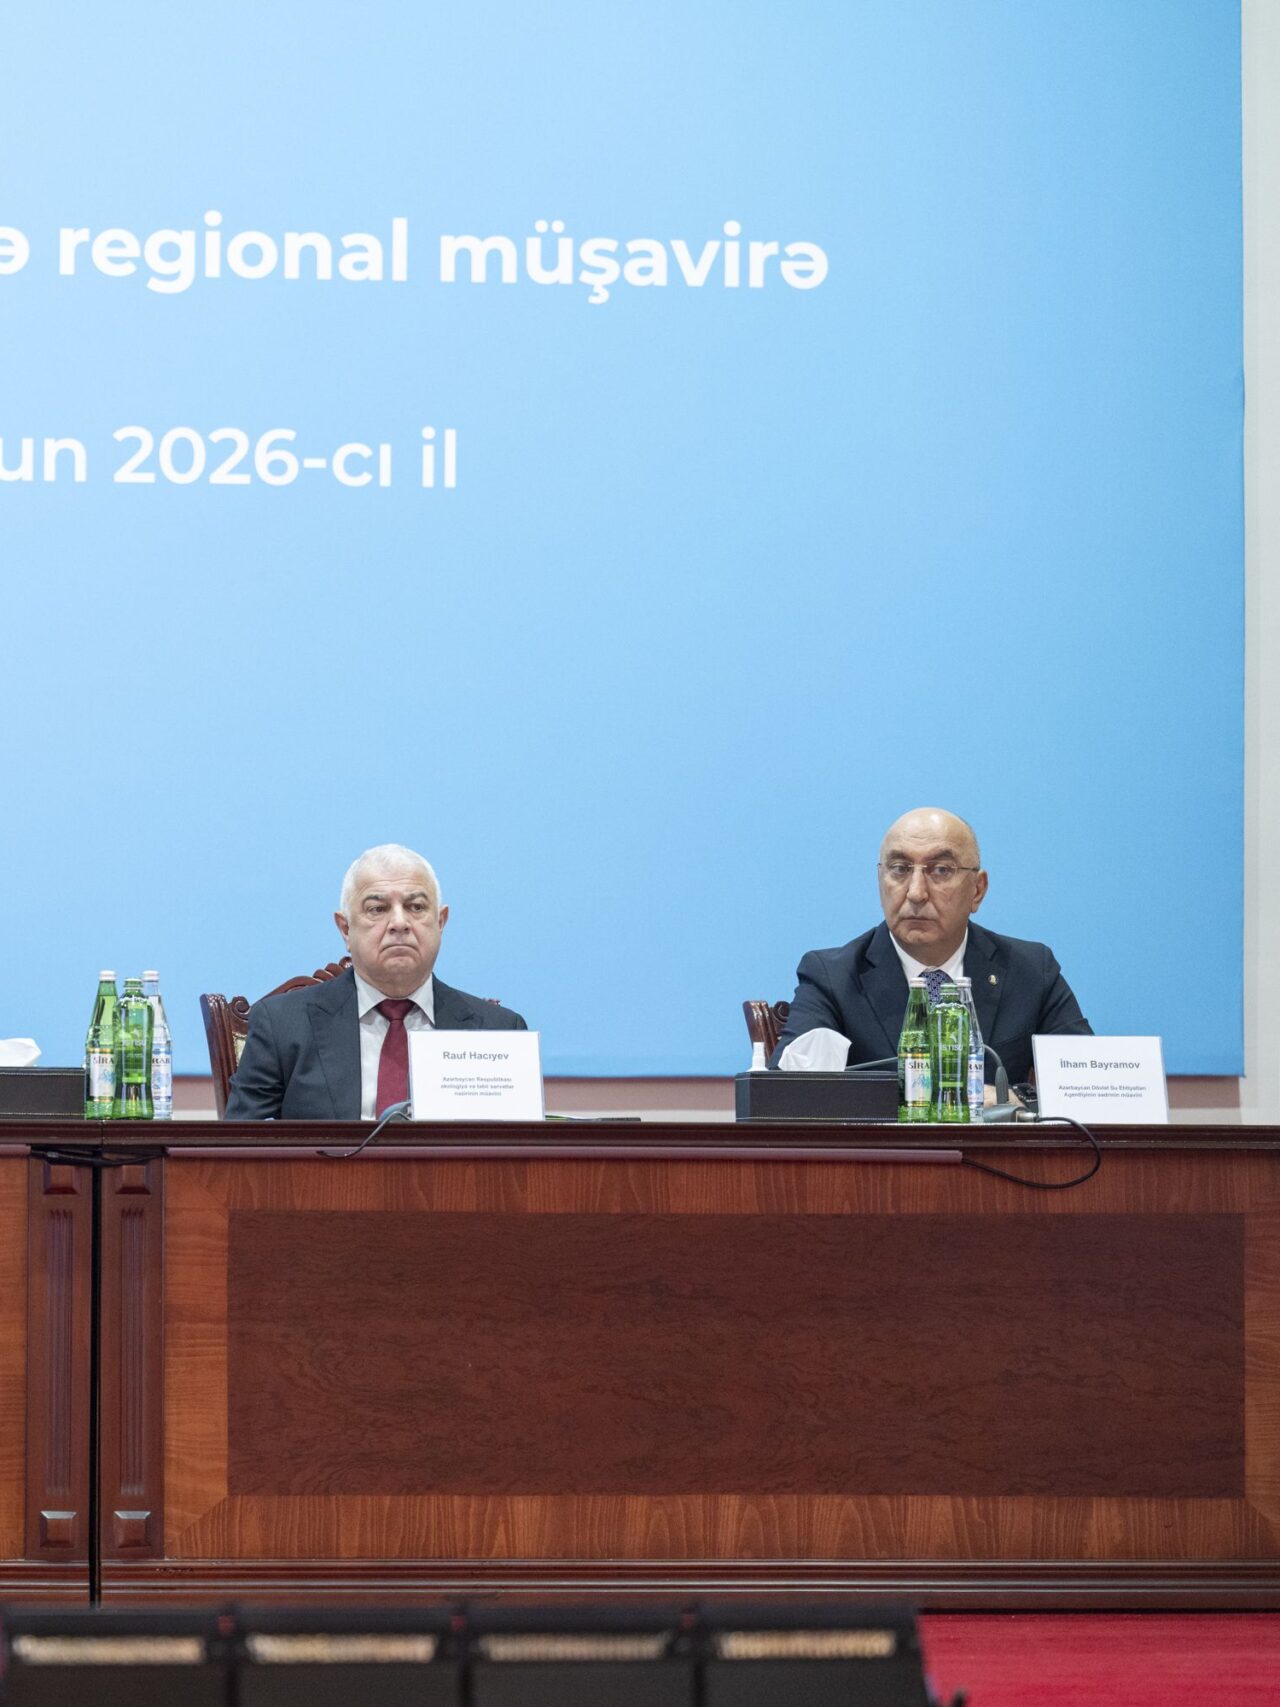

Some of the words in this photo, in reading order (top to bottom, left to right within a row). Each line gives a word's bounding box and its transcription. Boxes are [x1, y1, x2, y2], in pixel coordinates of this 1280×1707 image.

[58, 209, 408, 295] regional
[439, 219, 829, 305] müşavirə
[112, 425, 392, 488] 2026-cı
[421, 425, 457, 489] il
[442, 1051, 467, 1060] Rauf
[470, 1051, 509, 1061] Hacıyev
[1060, 1058, 1088, 1069] İlham
[1090, 1060, 1140, 1070] Bayramov
